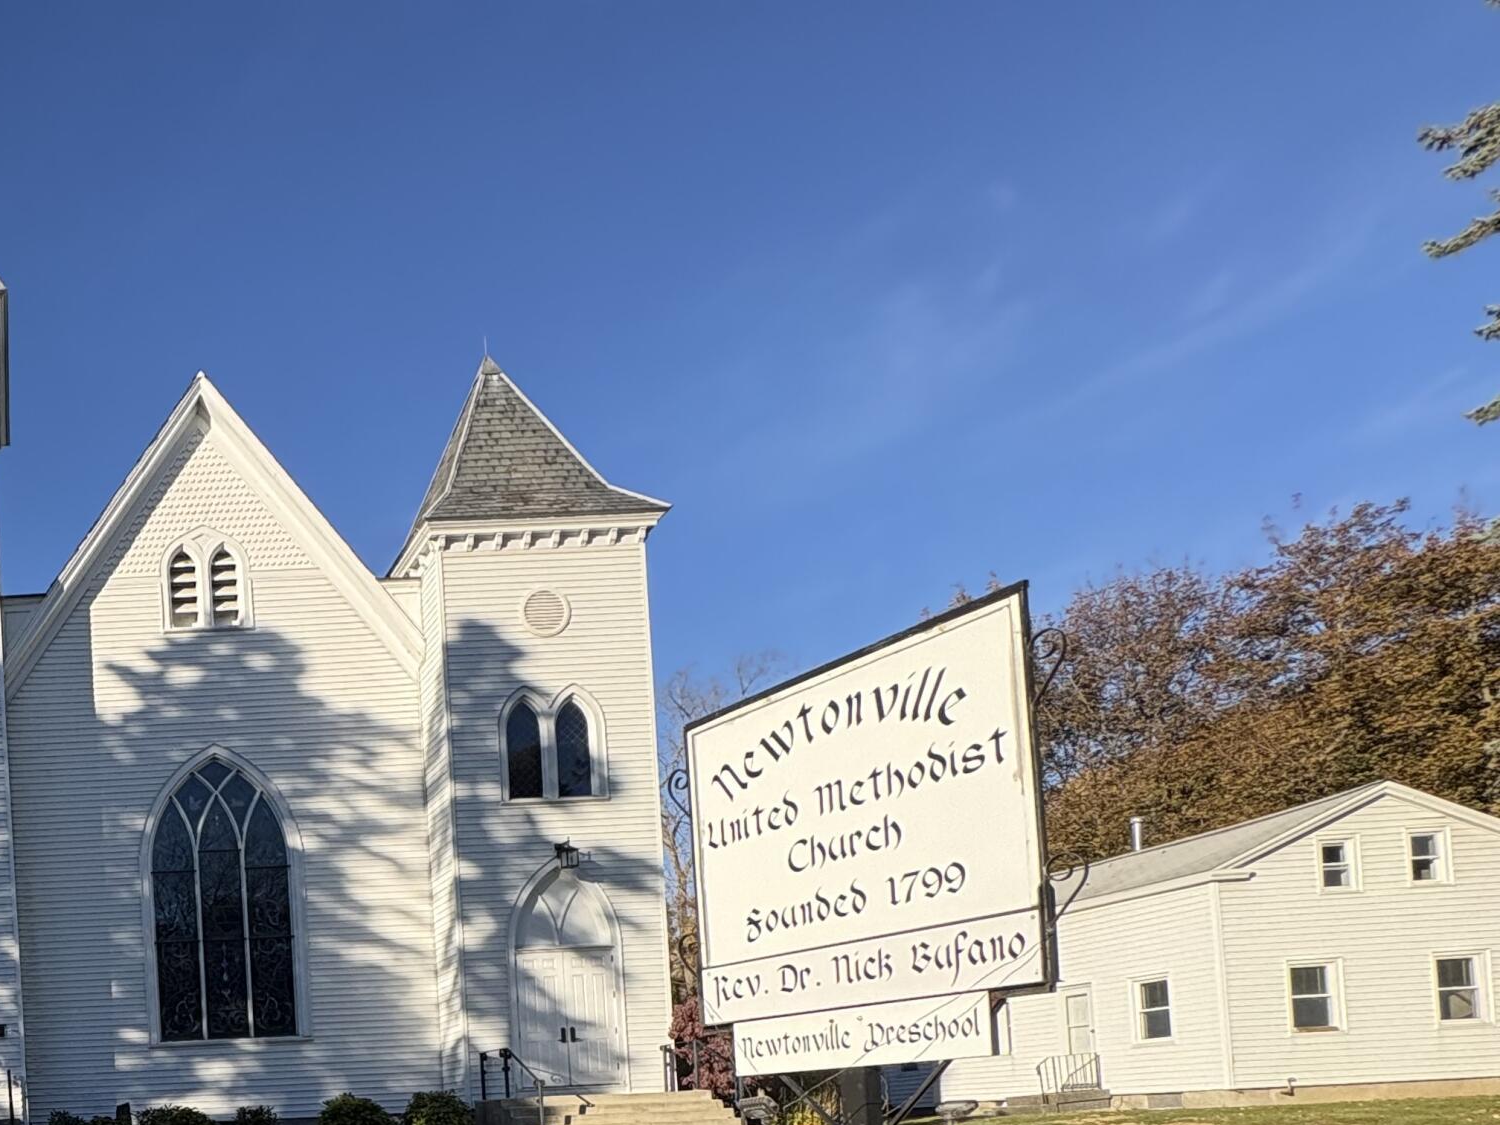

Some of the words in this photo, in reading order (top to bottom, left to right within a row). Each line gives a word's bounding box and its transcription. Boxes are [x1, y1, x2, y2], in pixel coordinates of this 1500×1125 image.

[711, 666, 967, 802] Newtonville
[706, 790, 799, 850] United
[814, 726, 1009, 816] Methodist
[787, 814, 902, 873] Church
[885, 862, 967, 906] 1799
[713, 975, 769, 1009] Rev.
[780, 965, 821, 993] Dr.
[833, 950, 893, 984] Nick
[911, 931, 1026, 986] Bufano
[739, 1027, 852, 1063] Newtonville
[863, 1007, 981, 1053] Preschool
